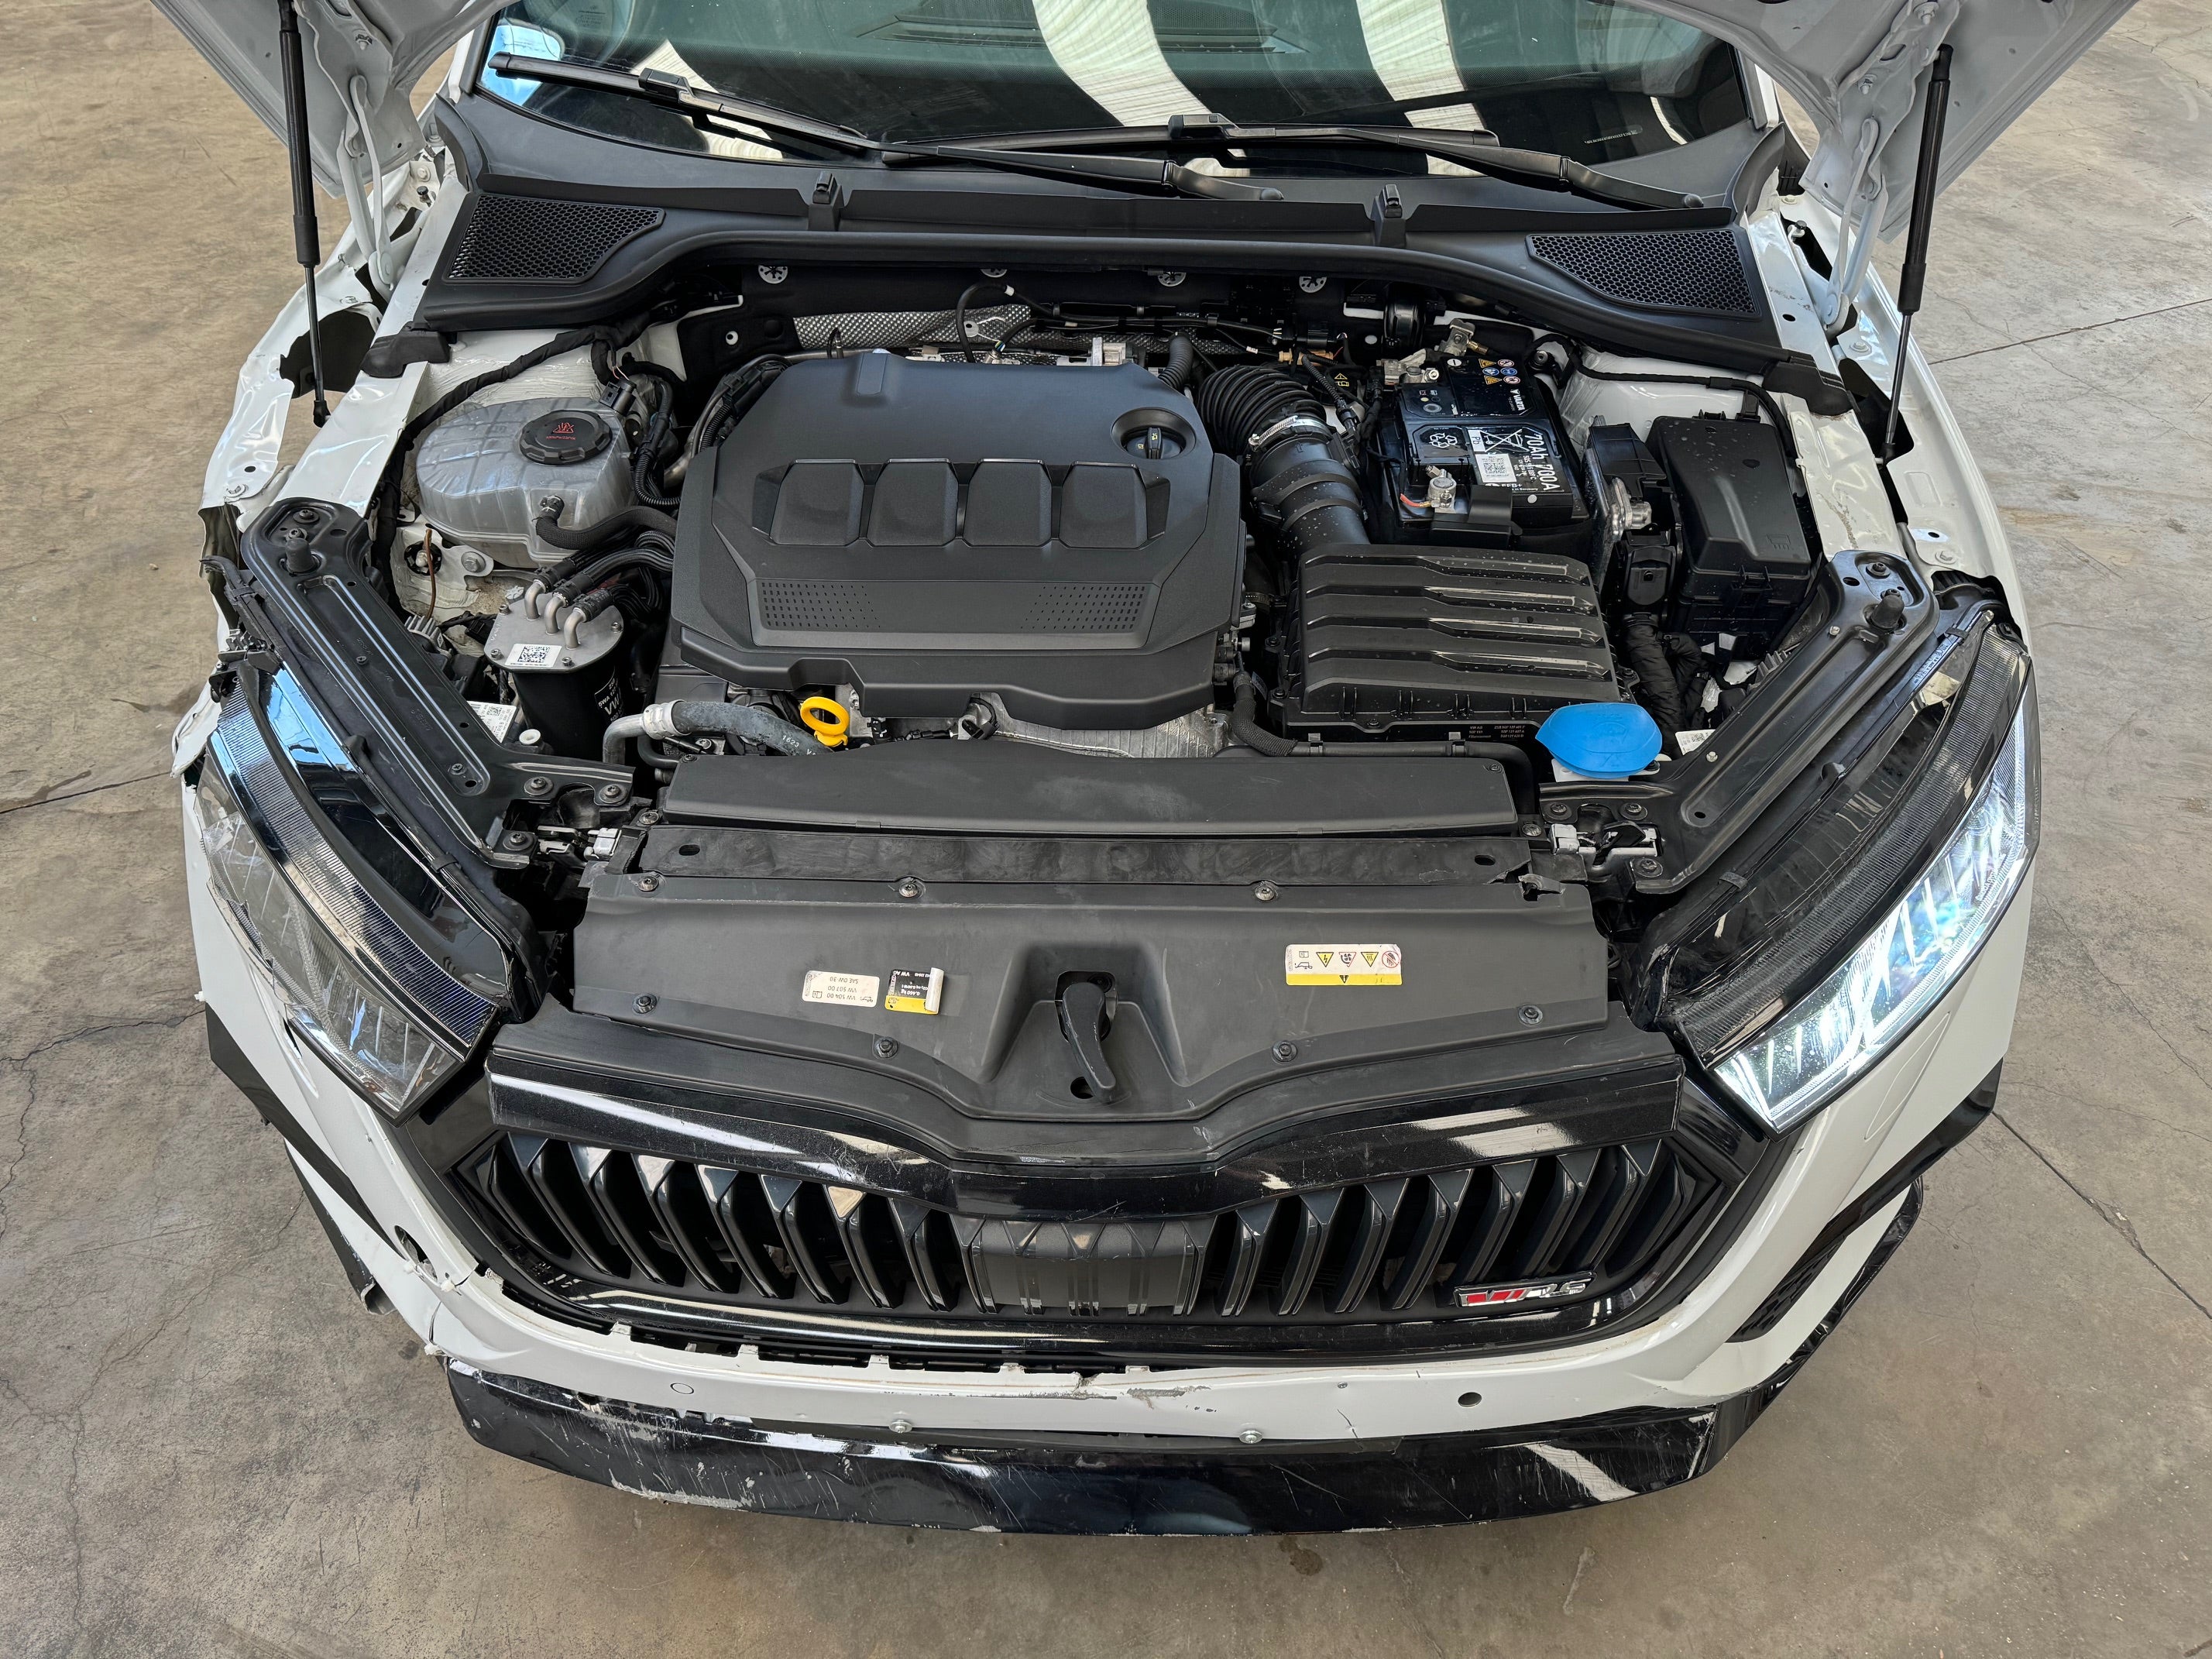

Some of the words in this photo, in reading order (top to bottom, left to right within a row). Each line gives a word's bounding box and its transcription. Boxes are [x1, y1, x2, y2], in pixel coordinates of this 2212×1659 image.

[1472, 436, 1482, 445] Pb
[1524, 434, 1549, 459] 70Ah
[1536, 464, 1561, 491] 700A
